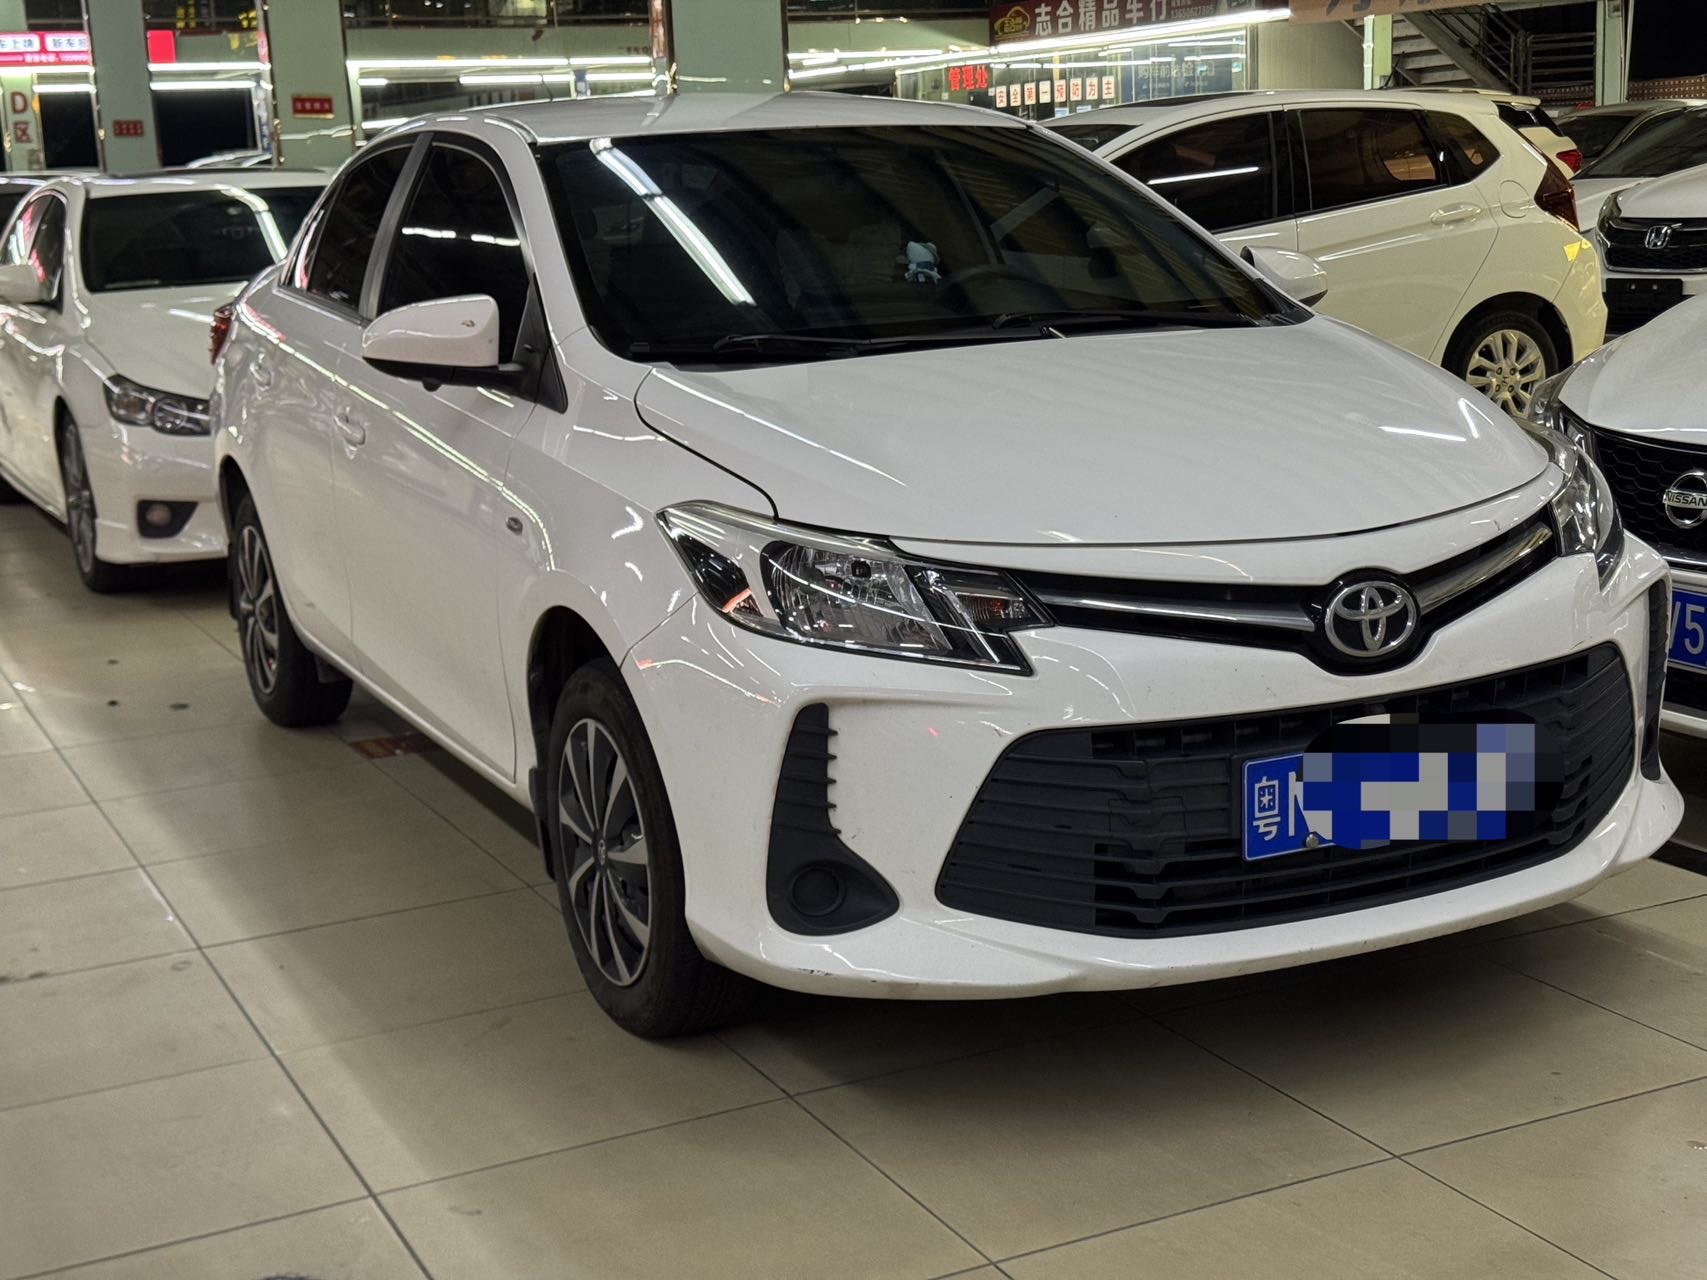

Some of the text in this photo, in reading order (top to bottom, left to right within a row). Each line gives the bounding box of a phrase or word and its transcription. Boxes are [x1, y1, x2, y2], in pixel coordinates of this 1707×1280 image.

[948, 65, 988, 91] 管理处
[997, 79, 1114, 105] 安全第一预防为主
[1667, 491, 1707, 508] NISSAN
